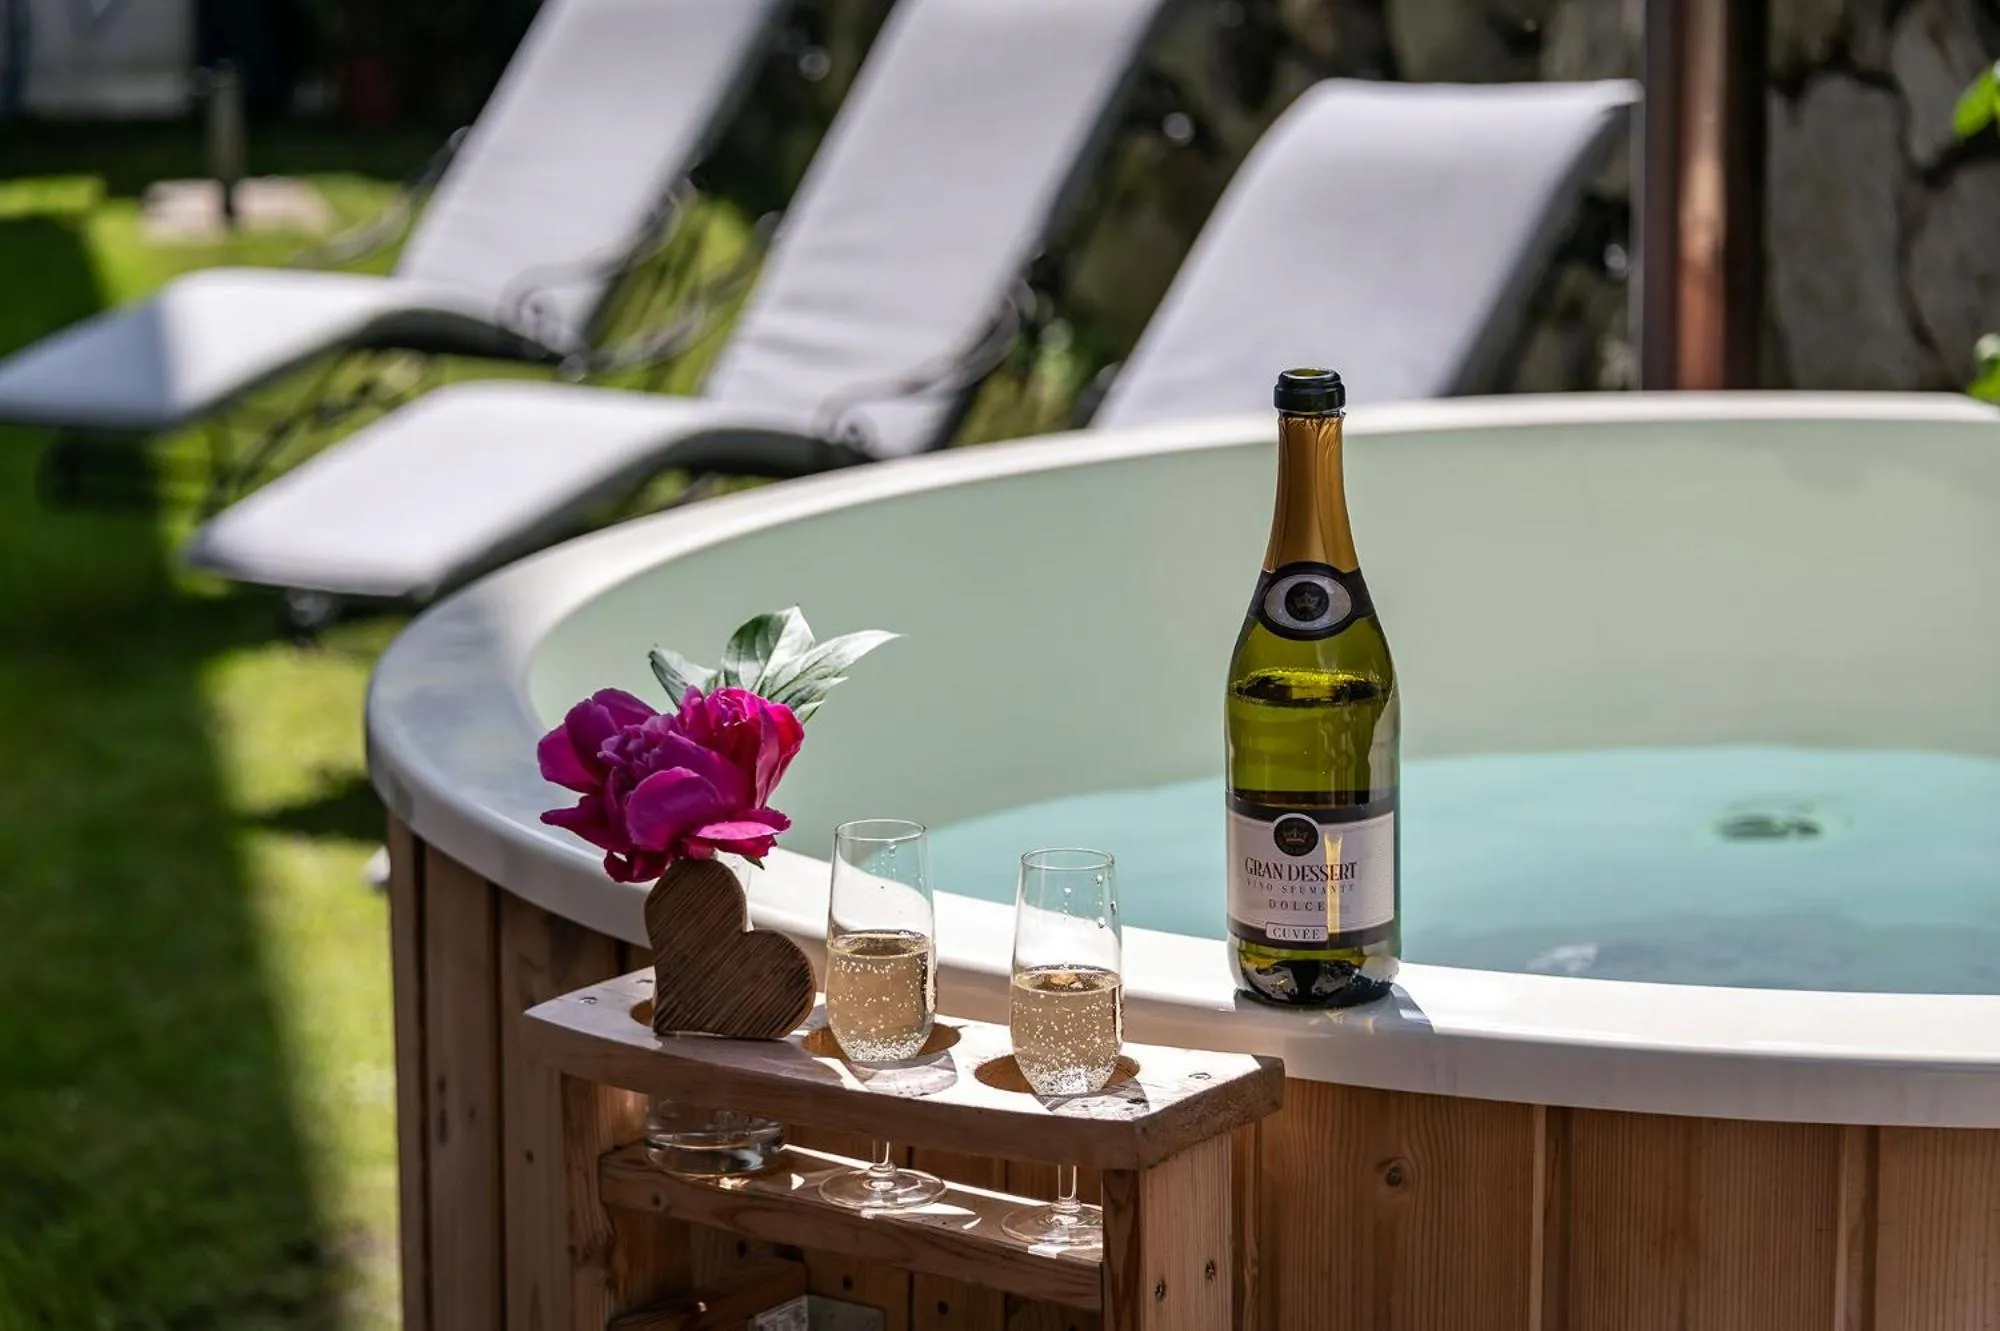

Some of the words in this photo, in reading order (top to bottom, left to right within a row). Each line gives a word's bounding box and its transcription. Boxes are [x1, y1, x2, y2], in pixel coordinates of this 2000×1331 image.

[1244, 857, 1283, 881] GRAN
[1285, 862, 1358, 882] DESSERT
[1268, 898, 1325, 912] DOLCE
[1272, 926, 1321, 940] CUVÉE
